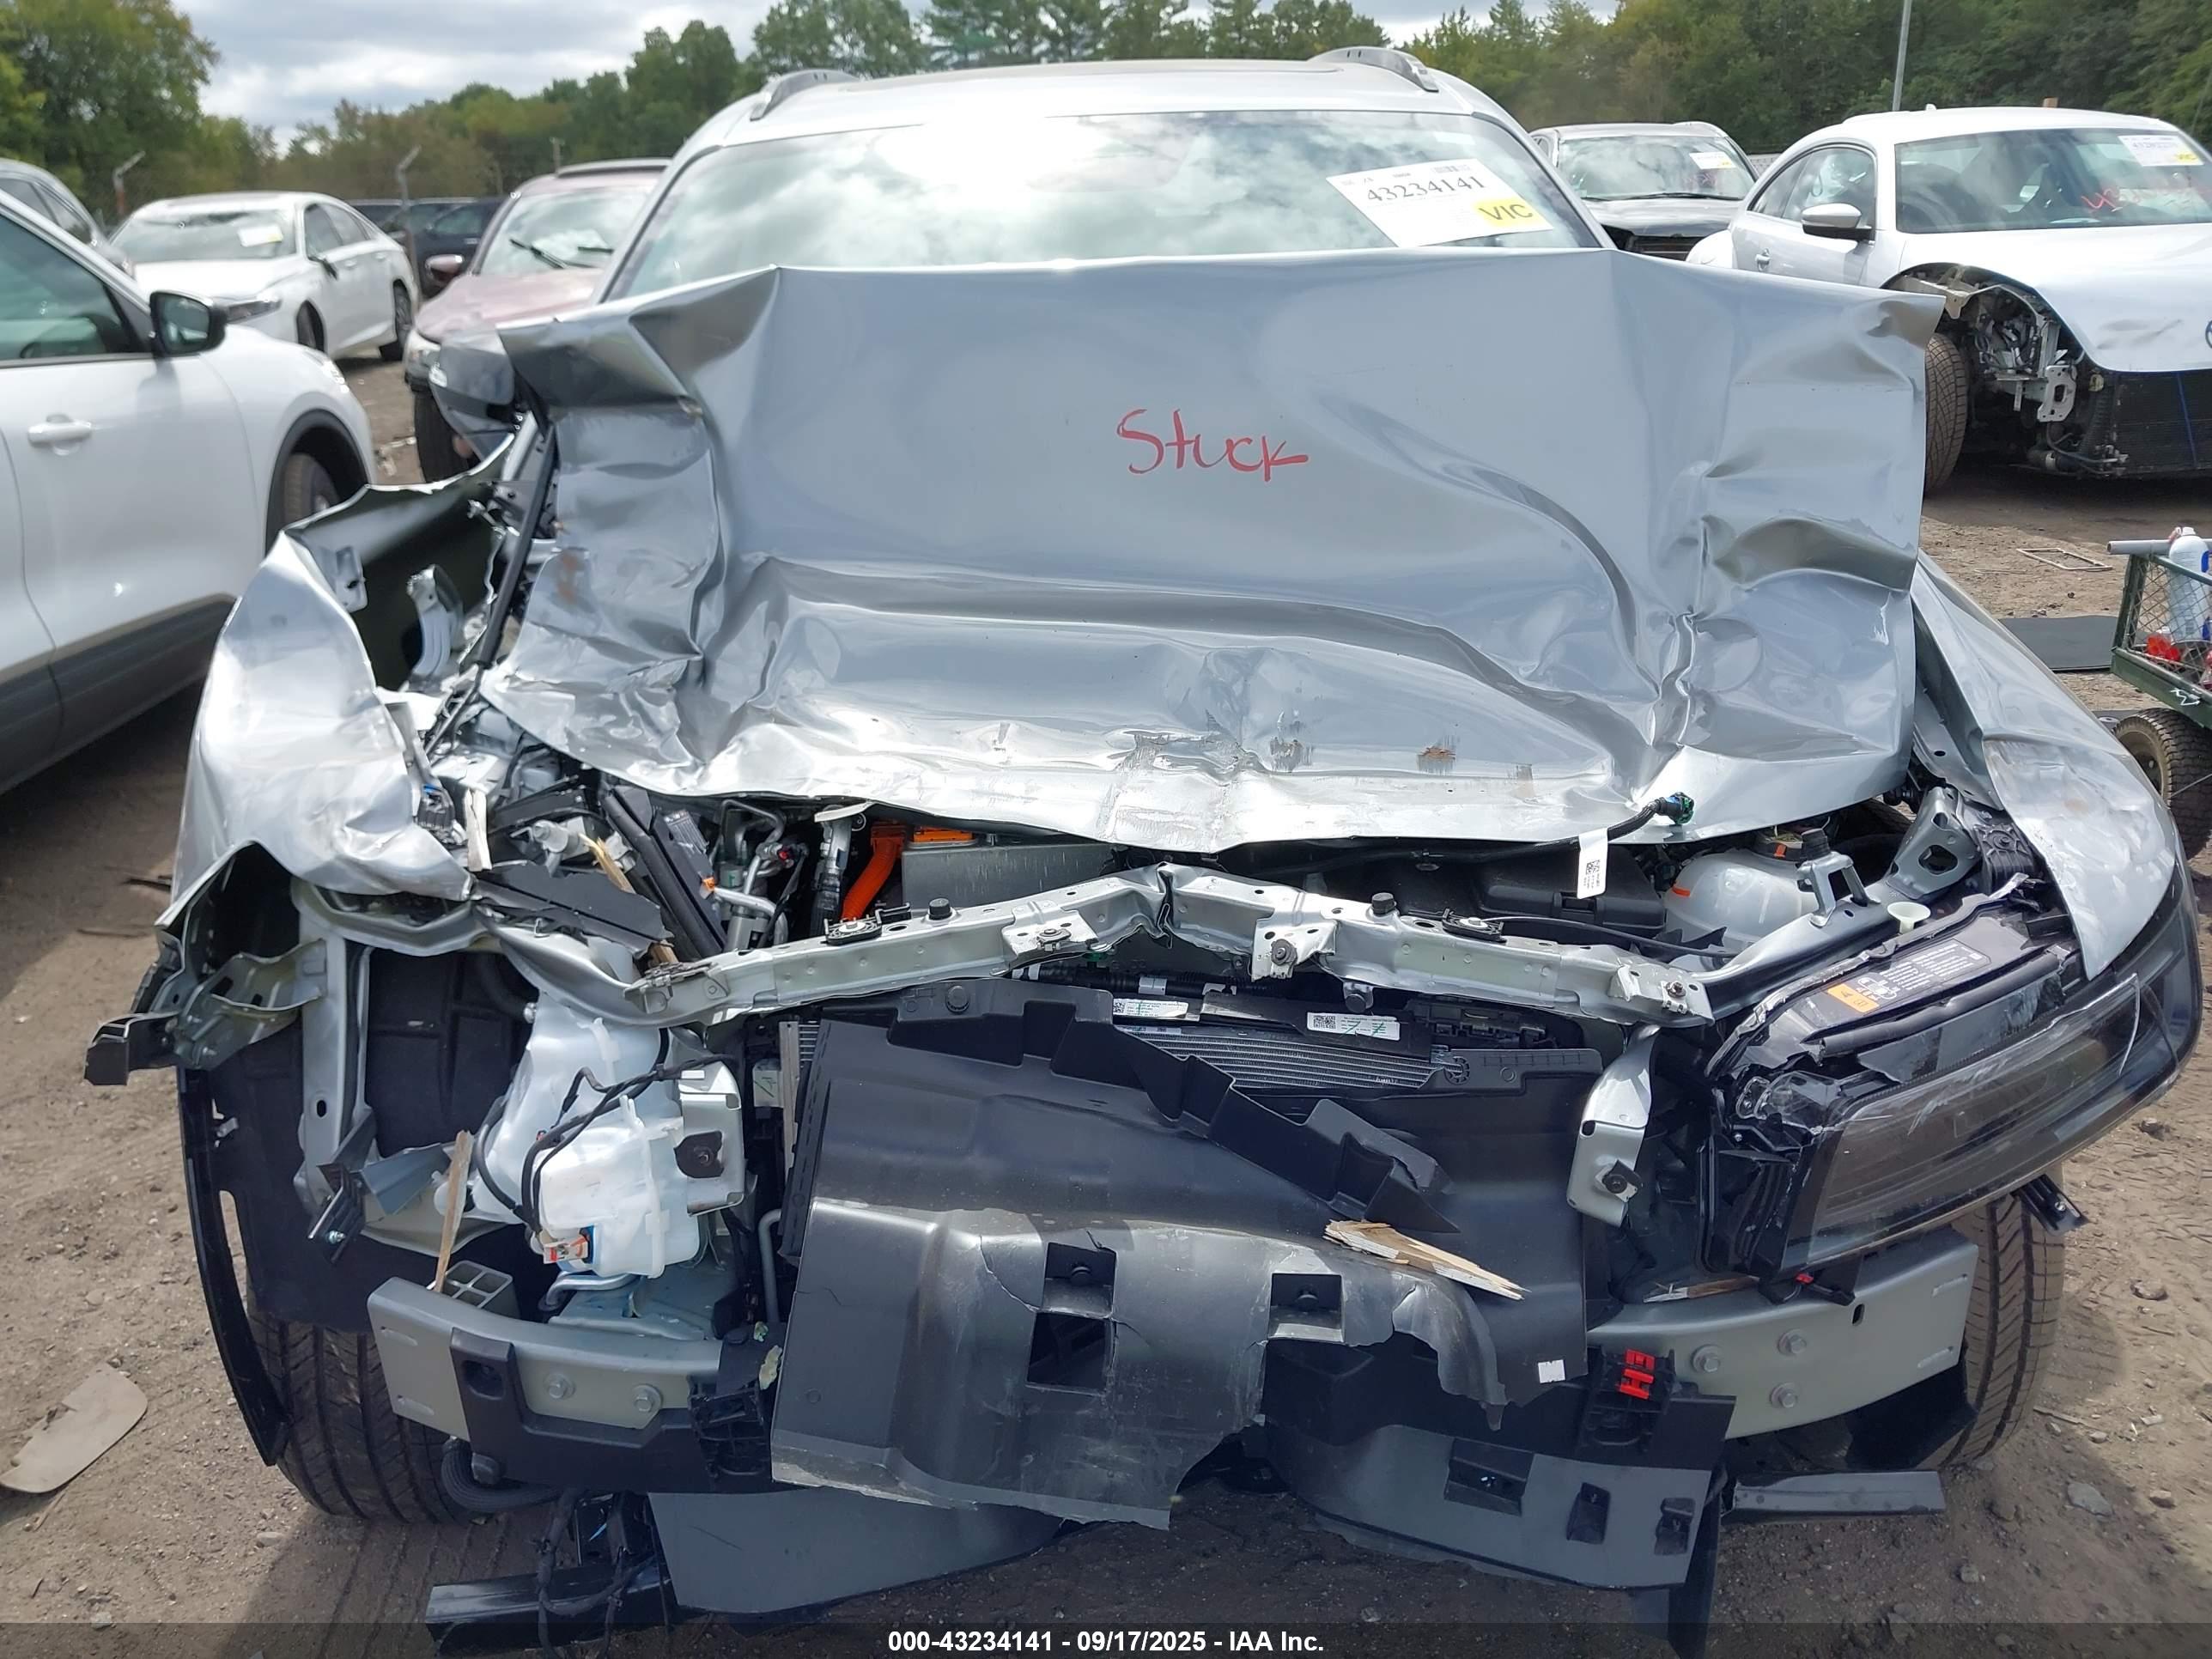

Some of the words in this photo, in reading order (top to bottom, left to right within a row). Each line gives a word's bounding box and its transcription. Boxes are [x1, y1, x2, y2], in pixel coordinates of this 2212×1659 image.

[1367, 175, 1486, 202] 43234141
[1479, 204, 1534, 222] VIC
[1116, 408, 1310, 483] Stuck
